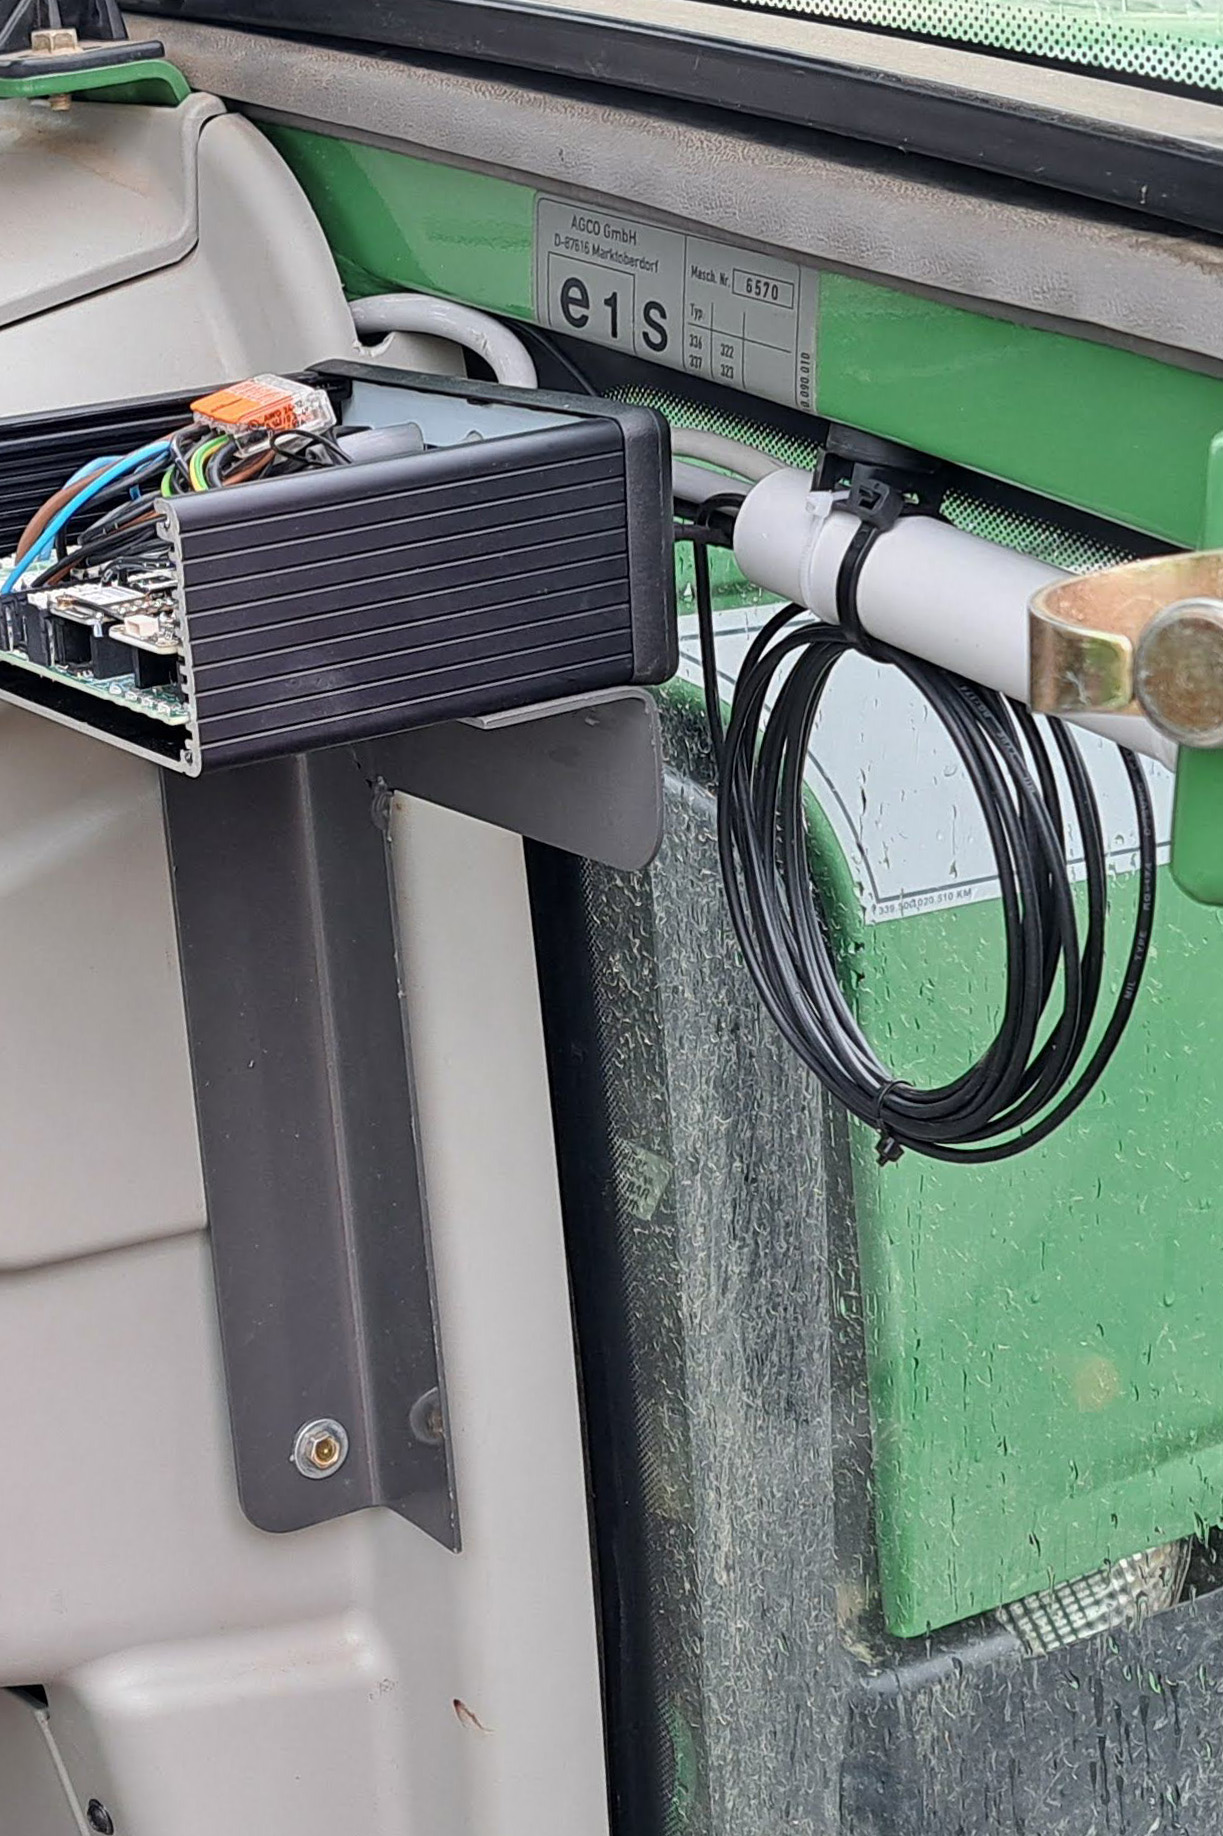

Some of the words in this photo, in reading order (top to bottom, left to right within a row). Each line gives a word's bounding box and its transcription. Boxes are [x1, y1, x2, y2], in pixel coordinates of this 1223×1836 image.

[571, 215, 600, 236] AGCO
[603, 226, 637, 245] GmbH
[554, 233, 590, 256] D-87616
[745, 276, 779, 301] 6570
[1124, 980, 1136, 1000] MIL
[1135, 930, 1148, 961] TYPE
